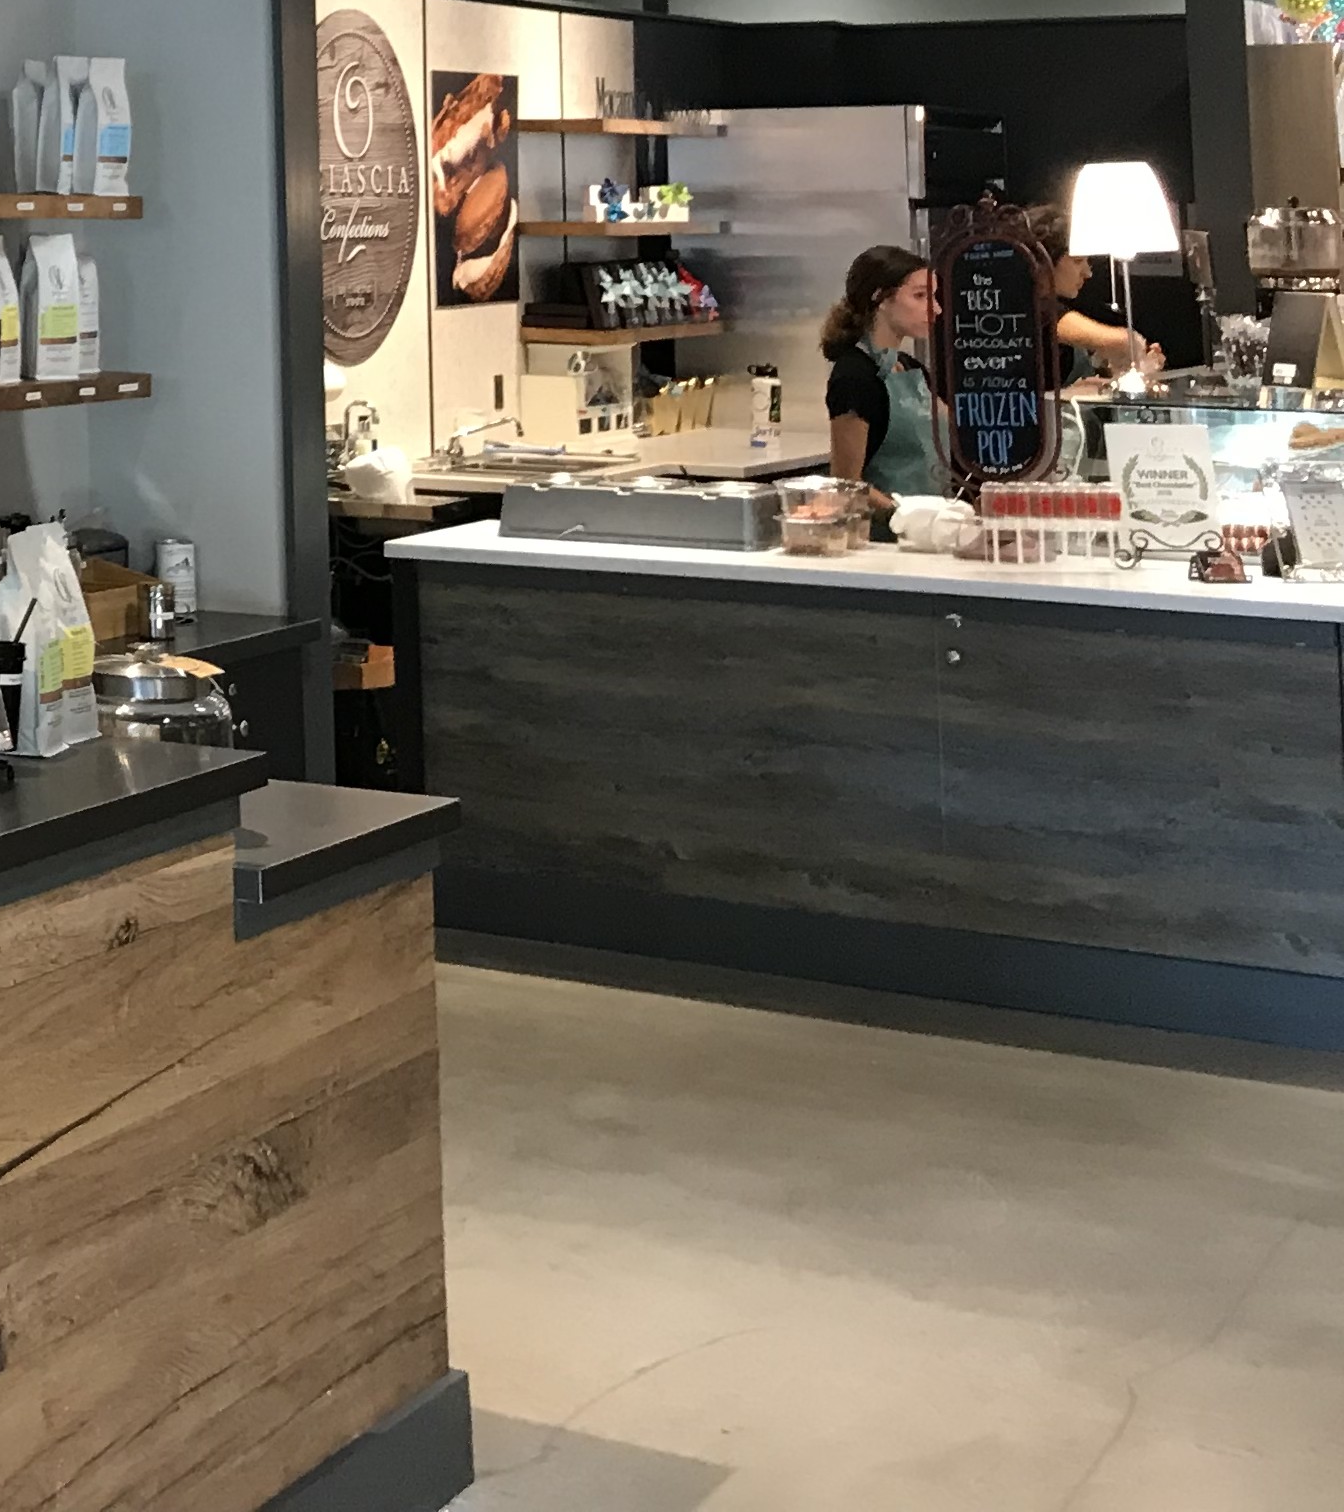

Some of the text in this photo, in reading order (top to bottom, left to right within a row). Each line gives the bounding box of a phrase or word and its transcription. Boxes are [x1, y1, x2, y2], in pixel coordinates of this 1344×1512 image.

[955, 314, 1026, 336] HOT
[954, 392, 1037, 427] FROZEN
[977, 429, 1013, 465] POP
